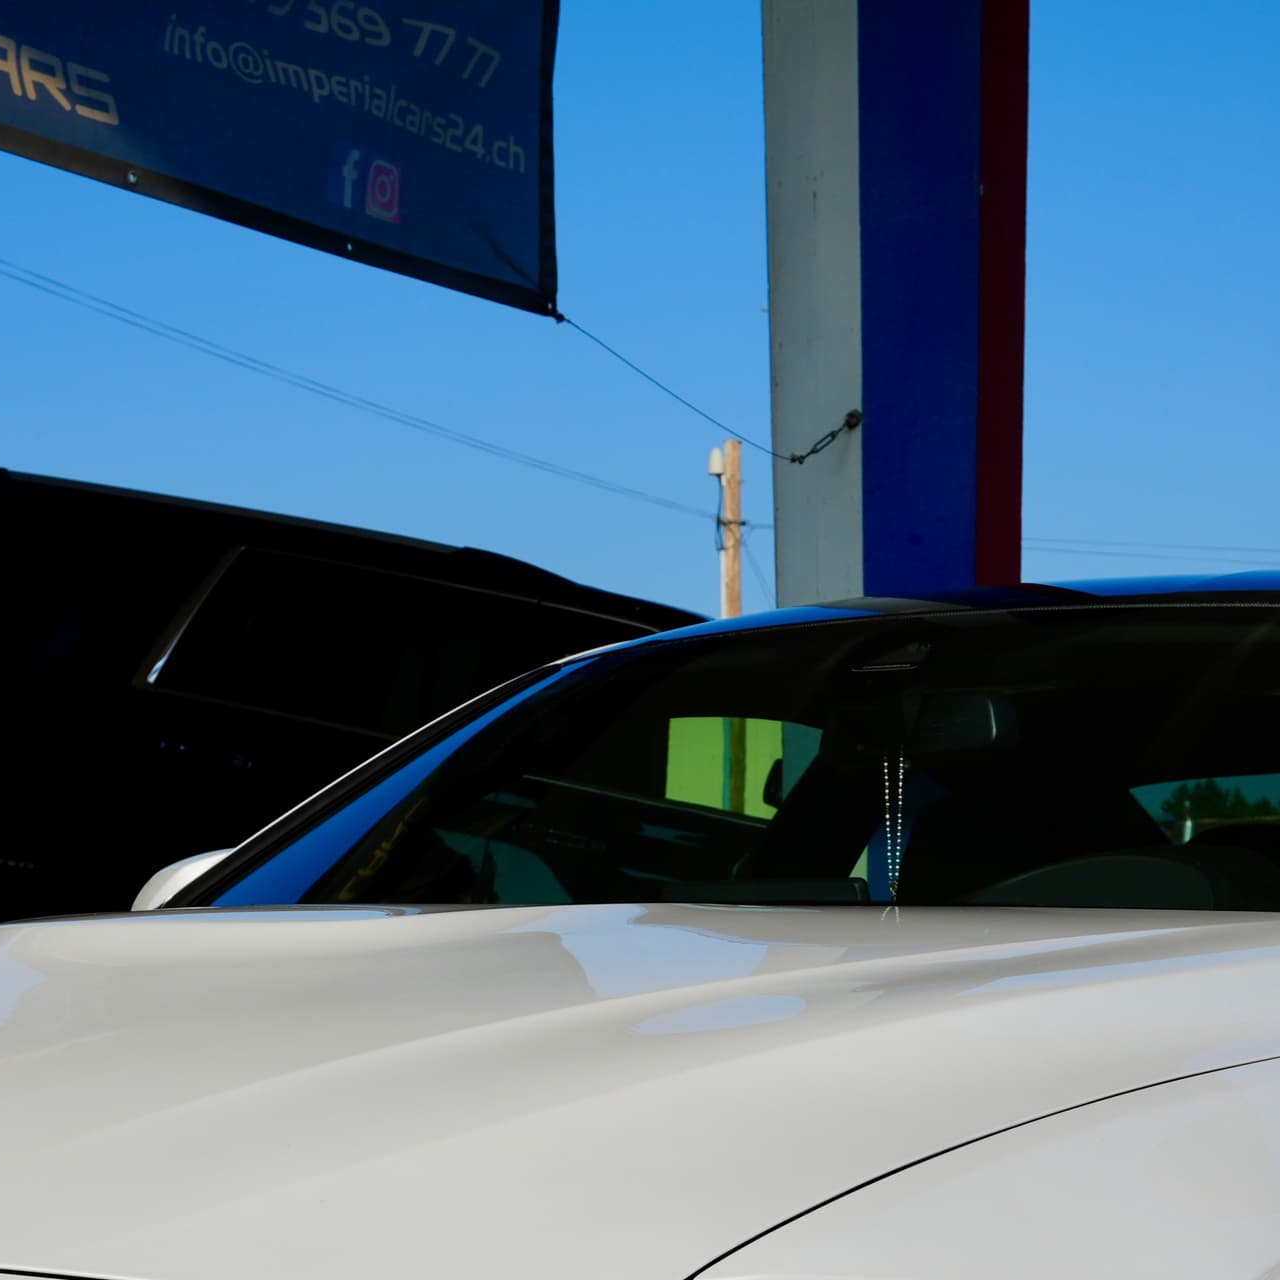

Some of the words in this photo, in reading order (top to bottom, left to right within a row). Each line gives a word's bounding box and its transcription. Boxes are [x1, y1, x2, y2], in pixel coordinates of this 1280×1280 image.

[162, 13, 527, 175] info@imperialcars24.ch
[401, 17, 457, 66] 77
[465, 37, 504, 89] 77
